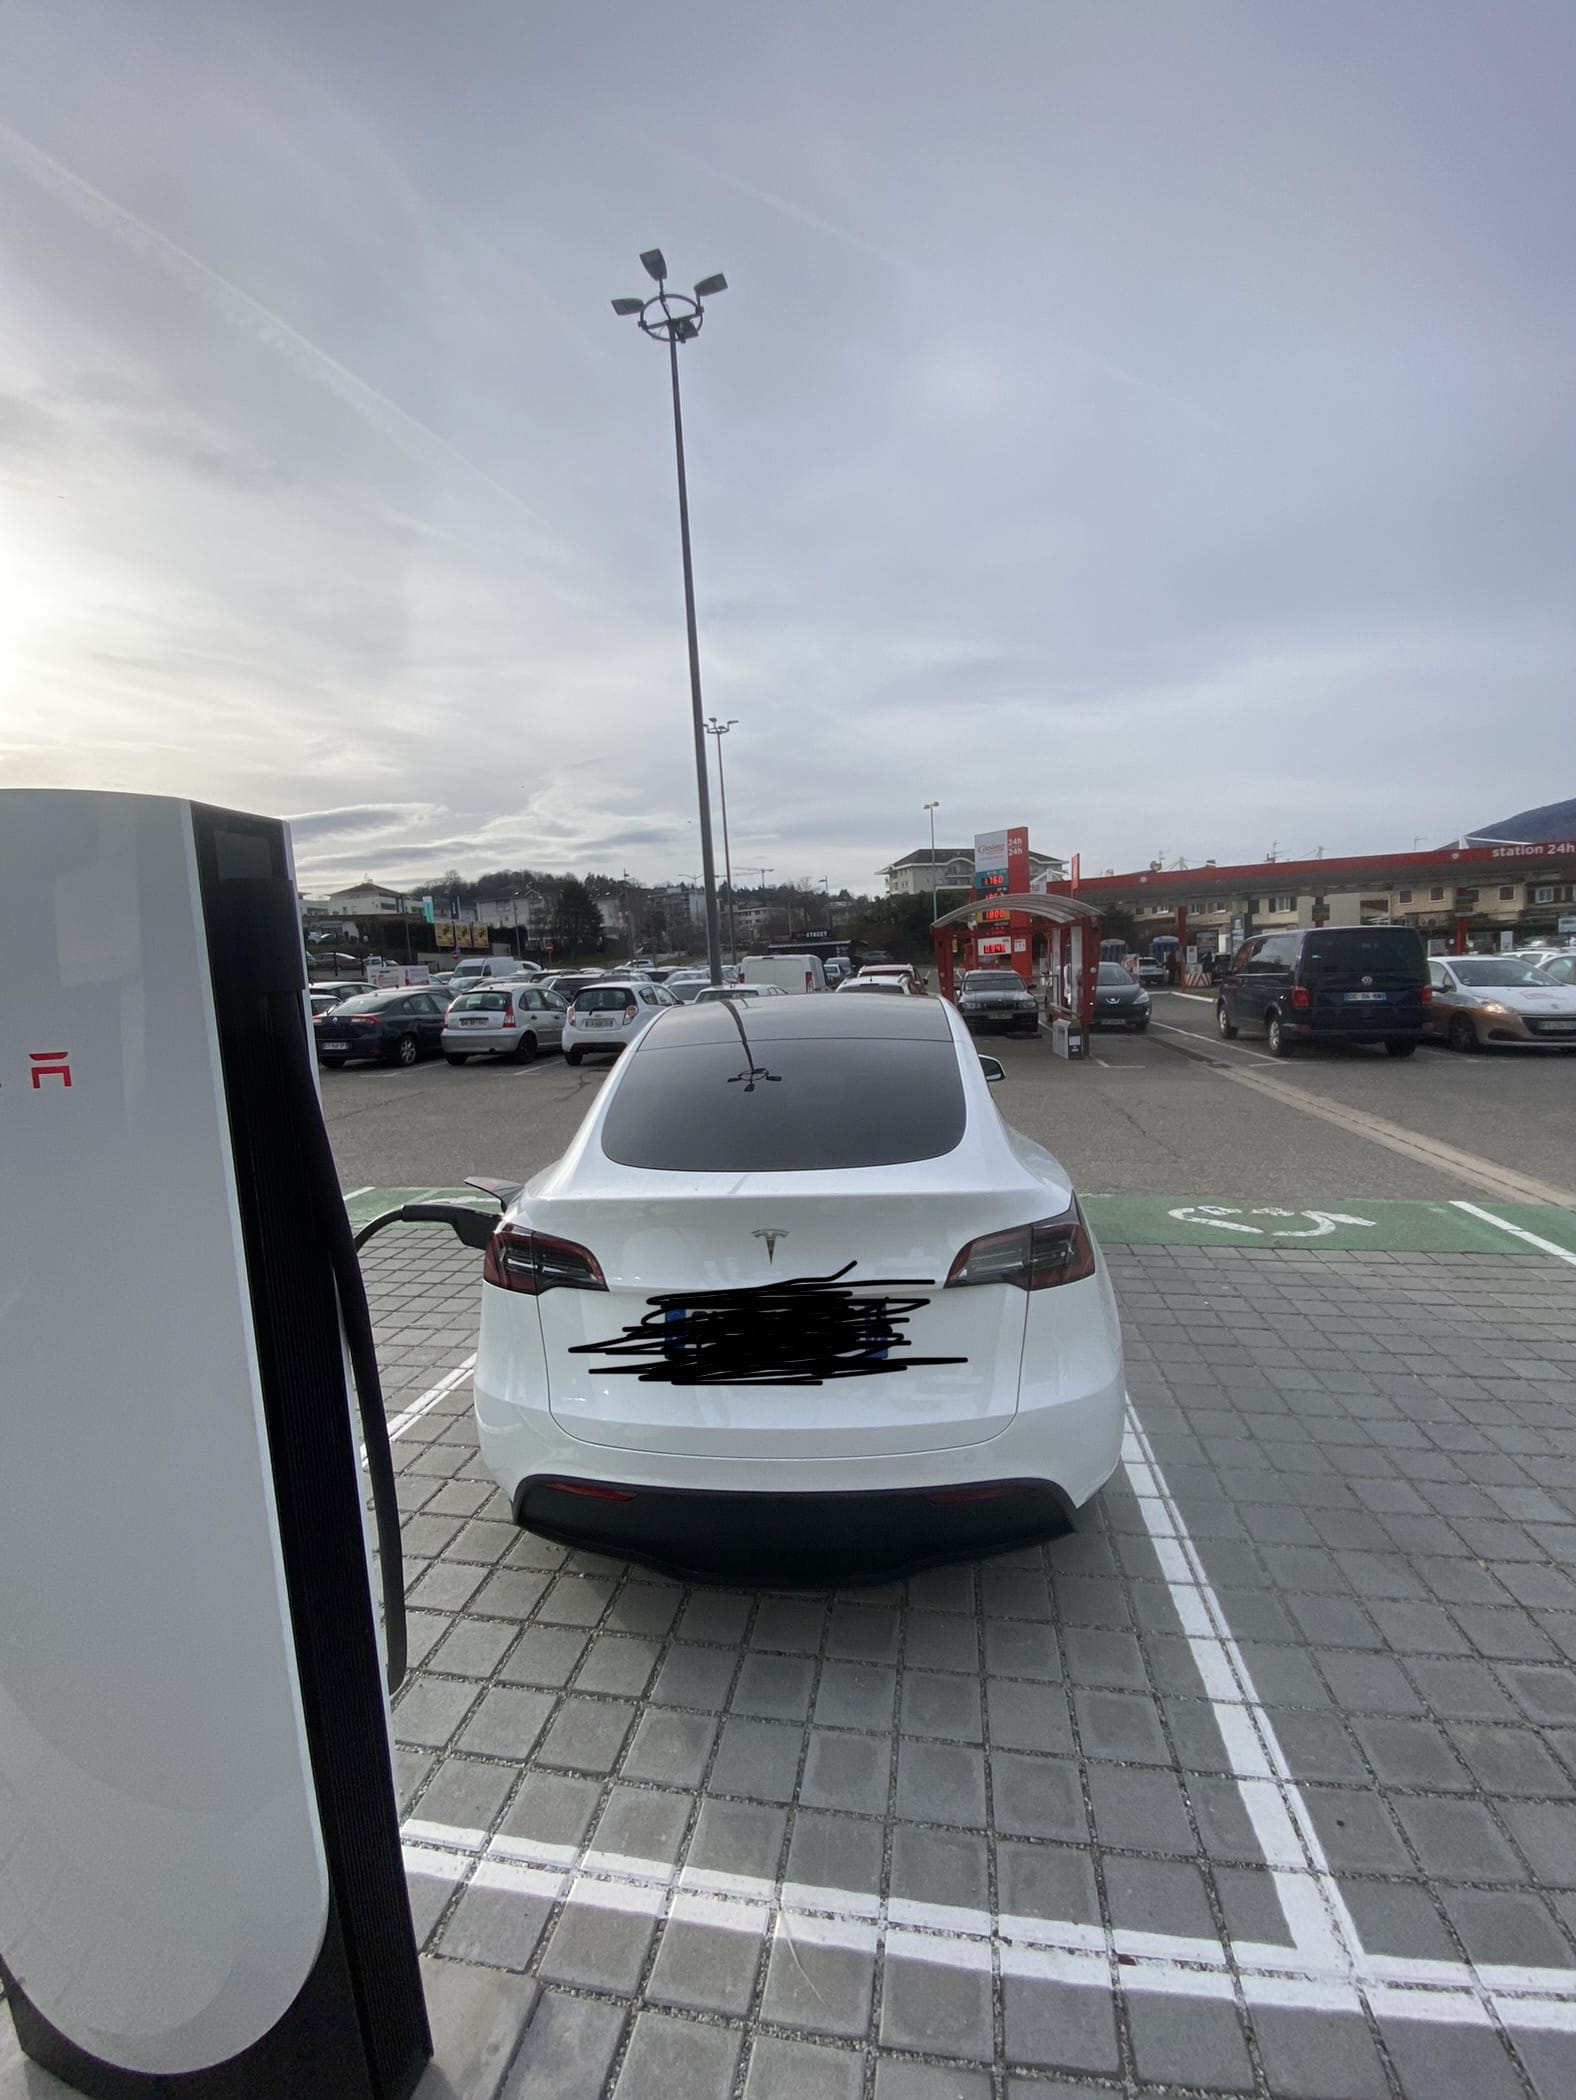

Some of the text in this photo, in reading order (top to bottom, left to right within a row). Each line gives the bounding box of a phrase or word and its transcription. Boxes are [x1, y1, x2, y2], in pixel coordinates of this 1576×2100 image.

[1008, 837, 1022, 846] 24h
[1008, 848, 1022, 856] 24h
[1492, 843, 1575, 857] station 24h
